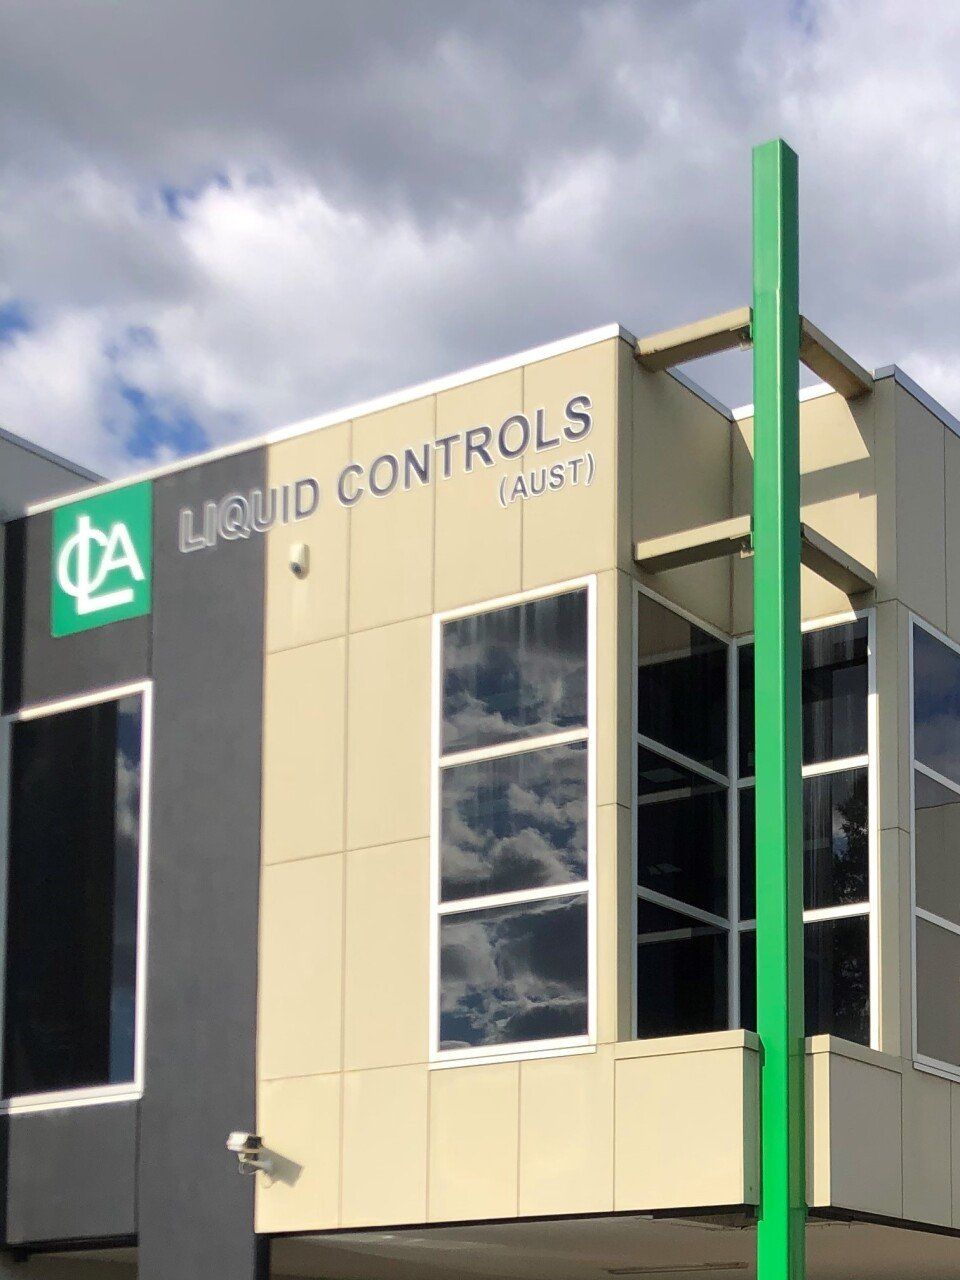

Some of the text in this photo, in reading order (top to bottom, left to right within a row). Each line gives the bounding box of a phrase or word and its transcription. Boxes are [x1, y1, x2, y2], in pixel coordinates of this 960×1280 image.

[178, 395, 593, 553] LIQUID CONTROLS
[499, 453, 596, 507] (AUST)
